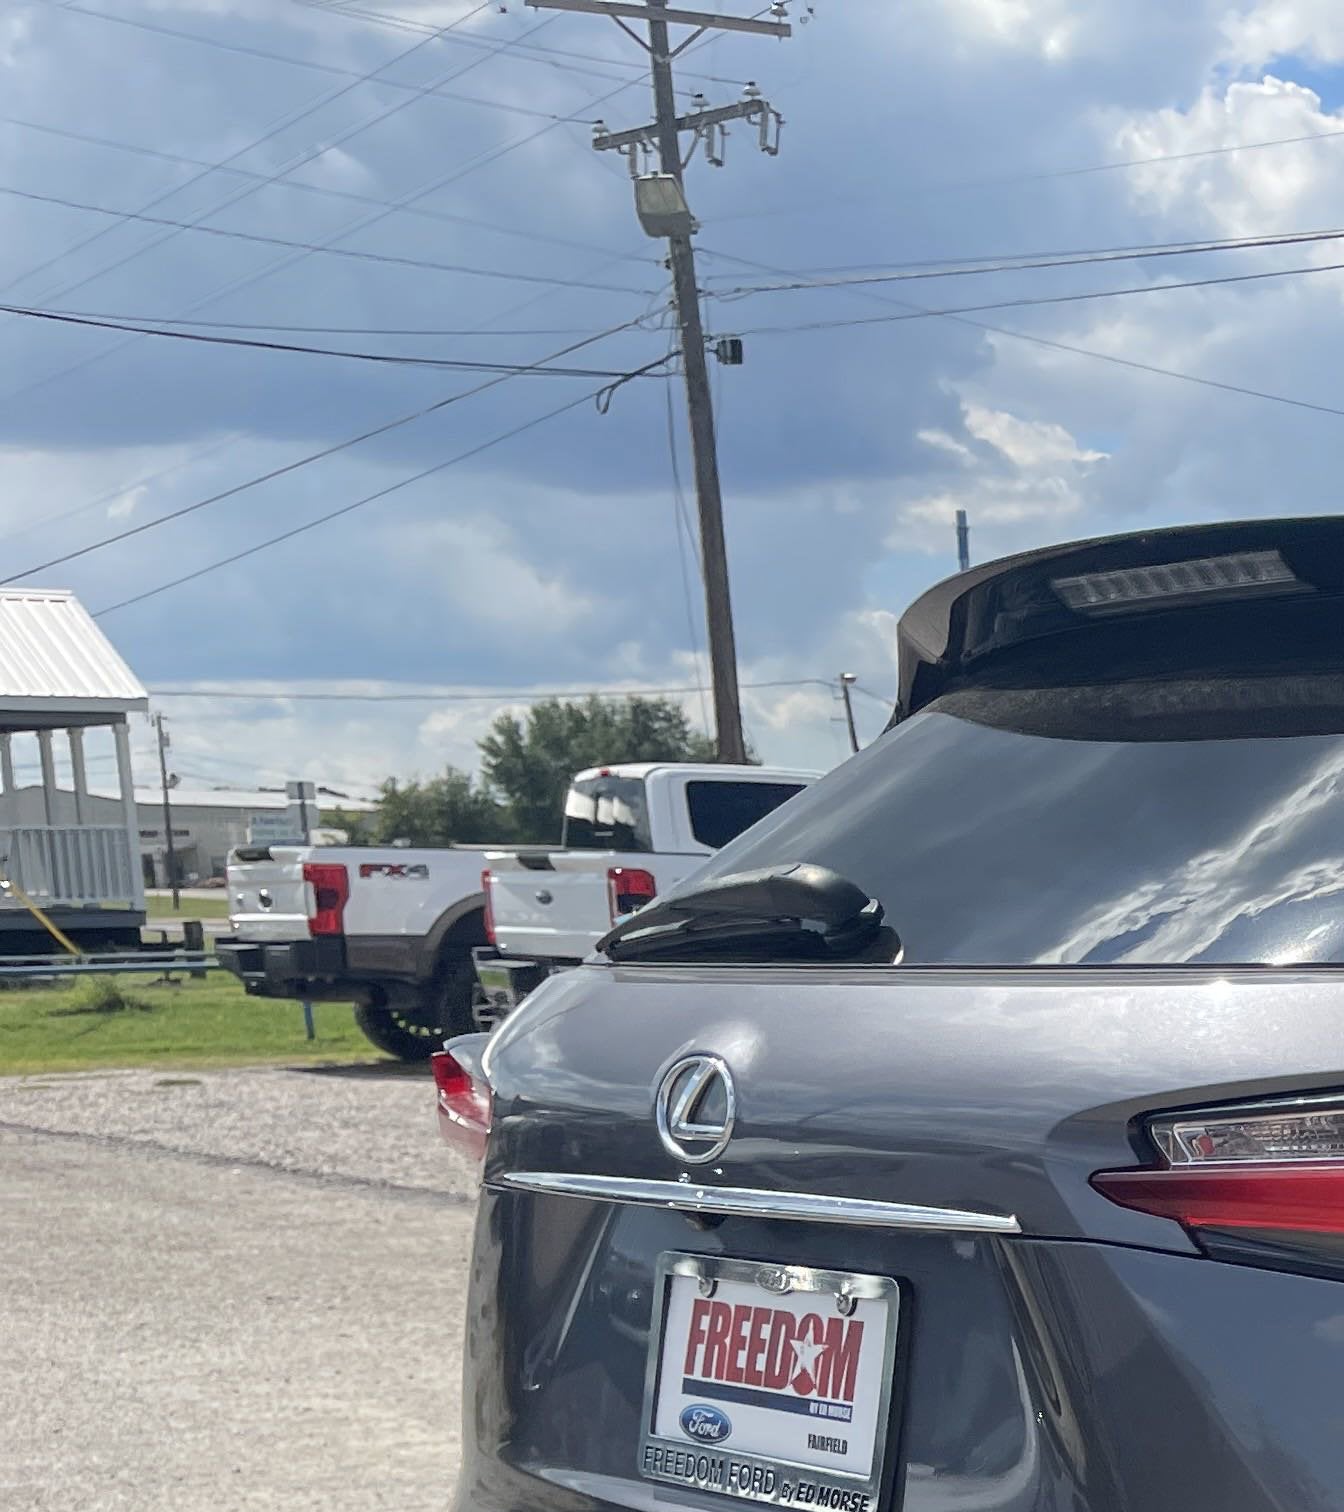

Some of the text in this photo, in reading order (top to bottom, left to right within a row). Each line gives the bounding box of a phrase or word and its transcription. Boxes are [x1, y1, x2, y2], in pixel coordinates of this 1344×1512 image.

[359, 864, 430, 880] FX4
[683, 1298, 864, 1402] FREEDOM
[688, 1409, 722, 1437] Ford
[807, 1433, 848, 1455] FAIRFIELD
[643, 1446, 724, 1486] FREEDOM
[727, 1462, 776, 1495] FORD
[796, 1482, 816, 1503] ED
